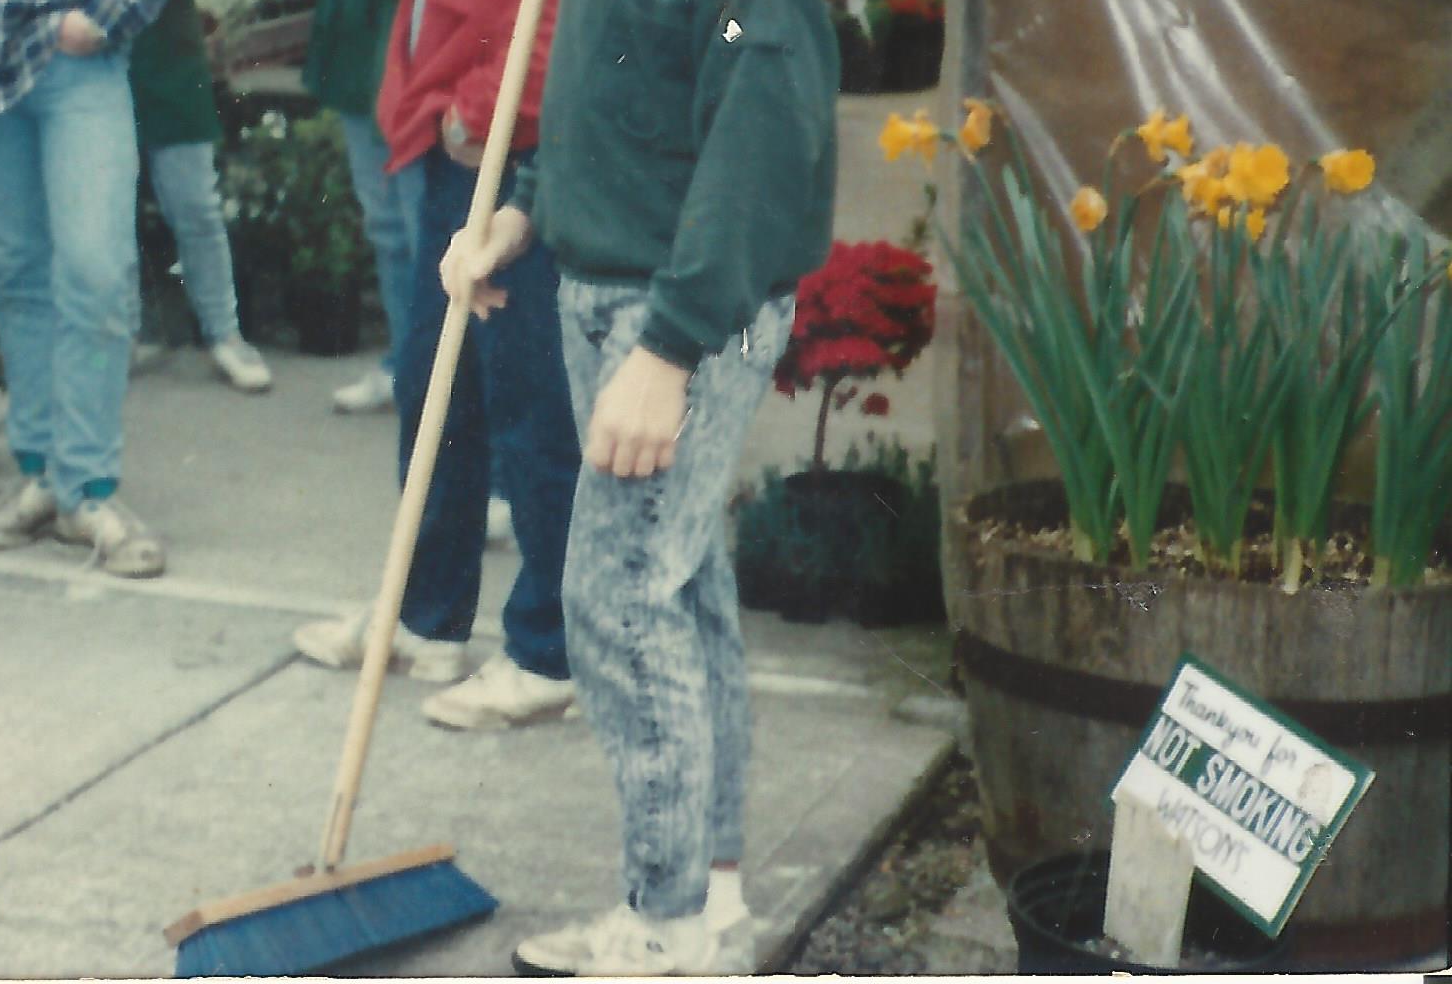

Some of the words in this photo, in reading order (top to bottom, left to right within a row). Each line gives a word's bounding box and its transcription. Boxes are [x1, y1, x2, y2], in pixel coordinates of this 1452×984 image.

[1148, 720, 1201, 777] NOT
[1199, 753, 1321, 863] SMOKING
[1261, 736, 1297, 777] for
